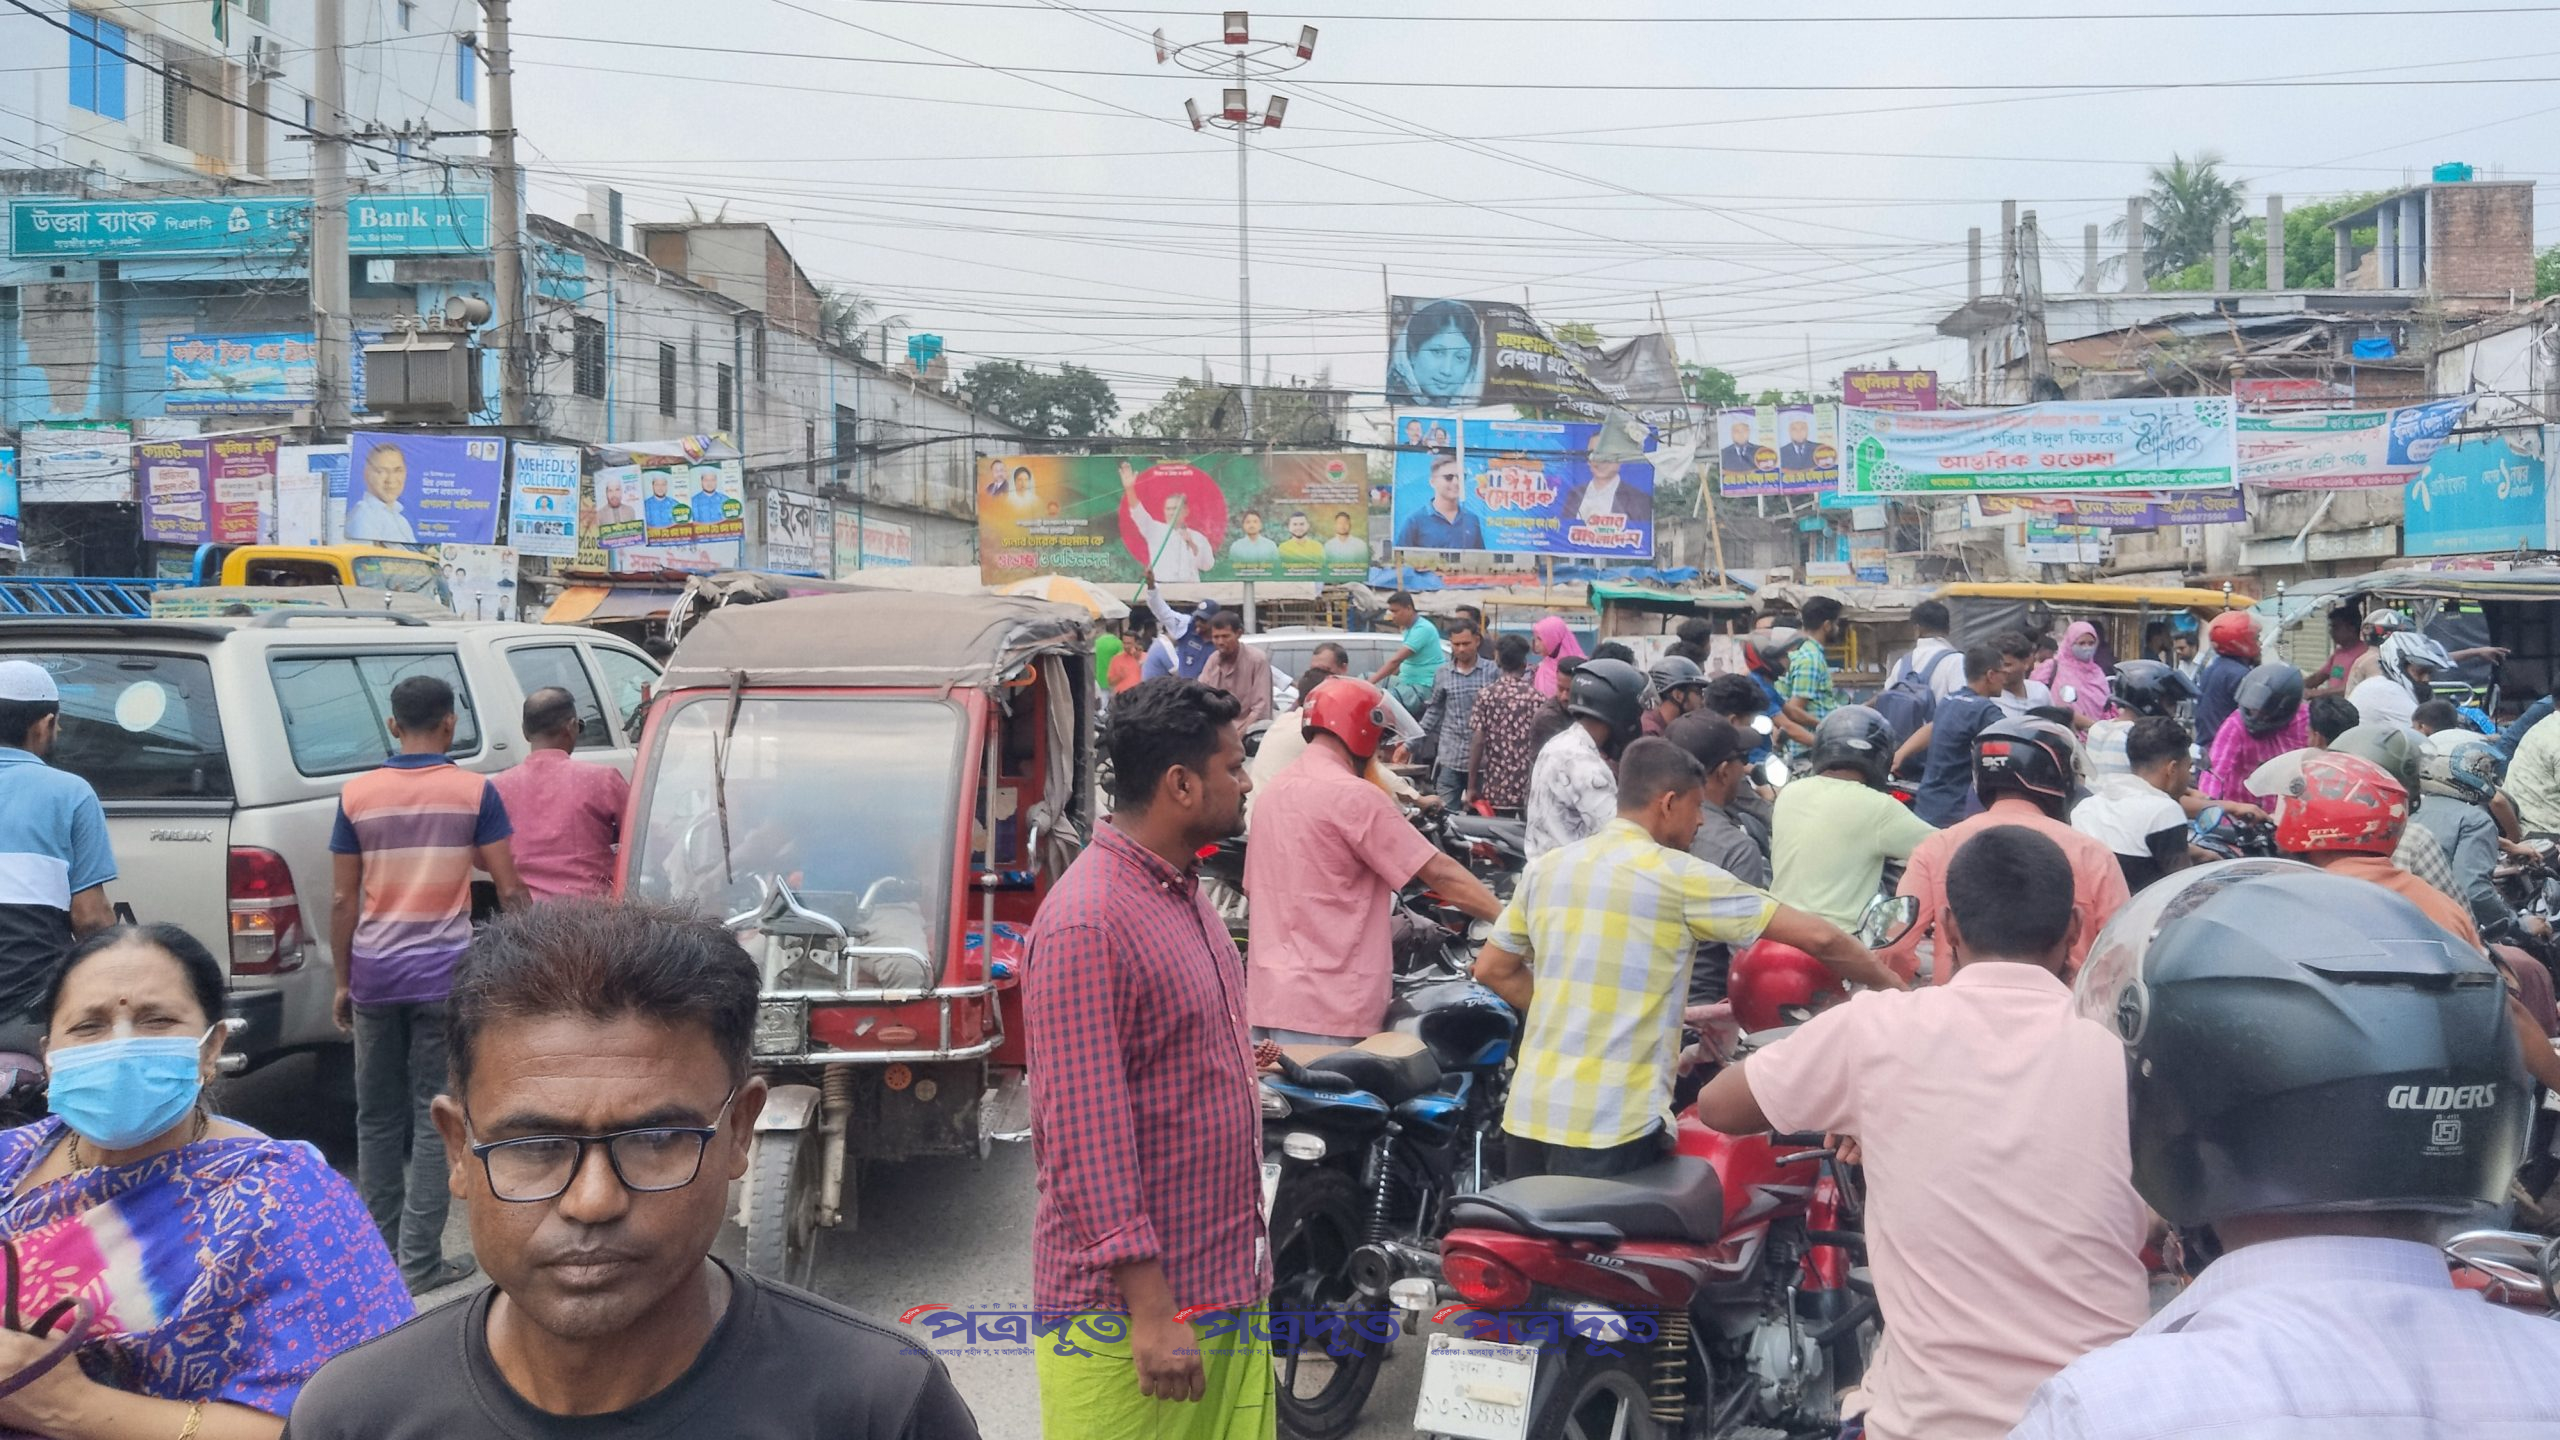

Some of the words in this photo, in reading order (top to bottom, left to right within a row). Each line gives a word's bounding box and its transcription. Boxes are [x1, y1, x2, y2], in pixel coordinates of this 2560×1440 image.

[31, 208, 91, 233] উত্তরা
[96, 210, 159, 233] ব্যাংক
[360, 206, 428, 228] Bank
[1496, 349, 1542, 373] বেগম
[2032, 432, 2063, 448] ঈদুল
[2069, 430, 2123, 445] ফিতরের
[519, 459, 577, 473] MEHEDI'S
[1938, 450, 2029, 471] আন্তরিক
[2040, 452, 2114, 467] শুভেচ্ছা
[520, 472, 576, 487] COLLECTION
[2388, 1083, 2497, 1110] GLIDERS
[1585, 1253, 1625, 1268] 100
